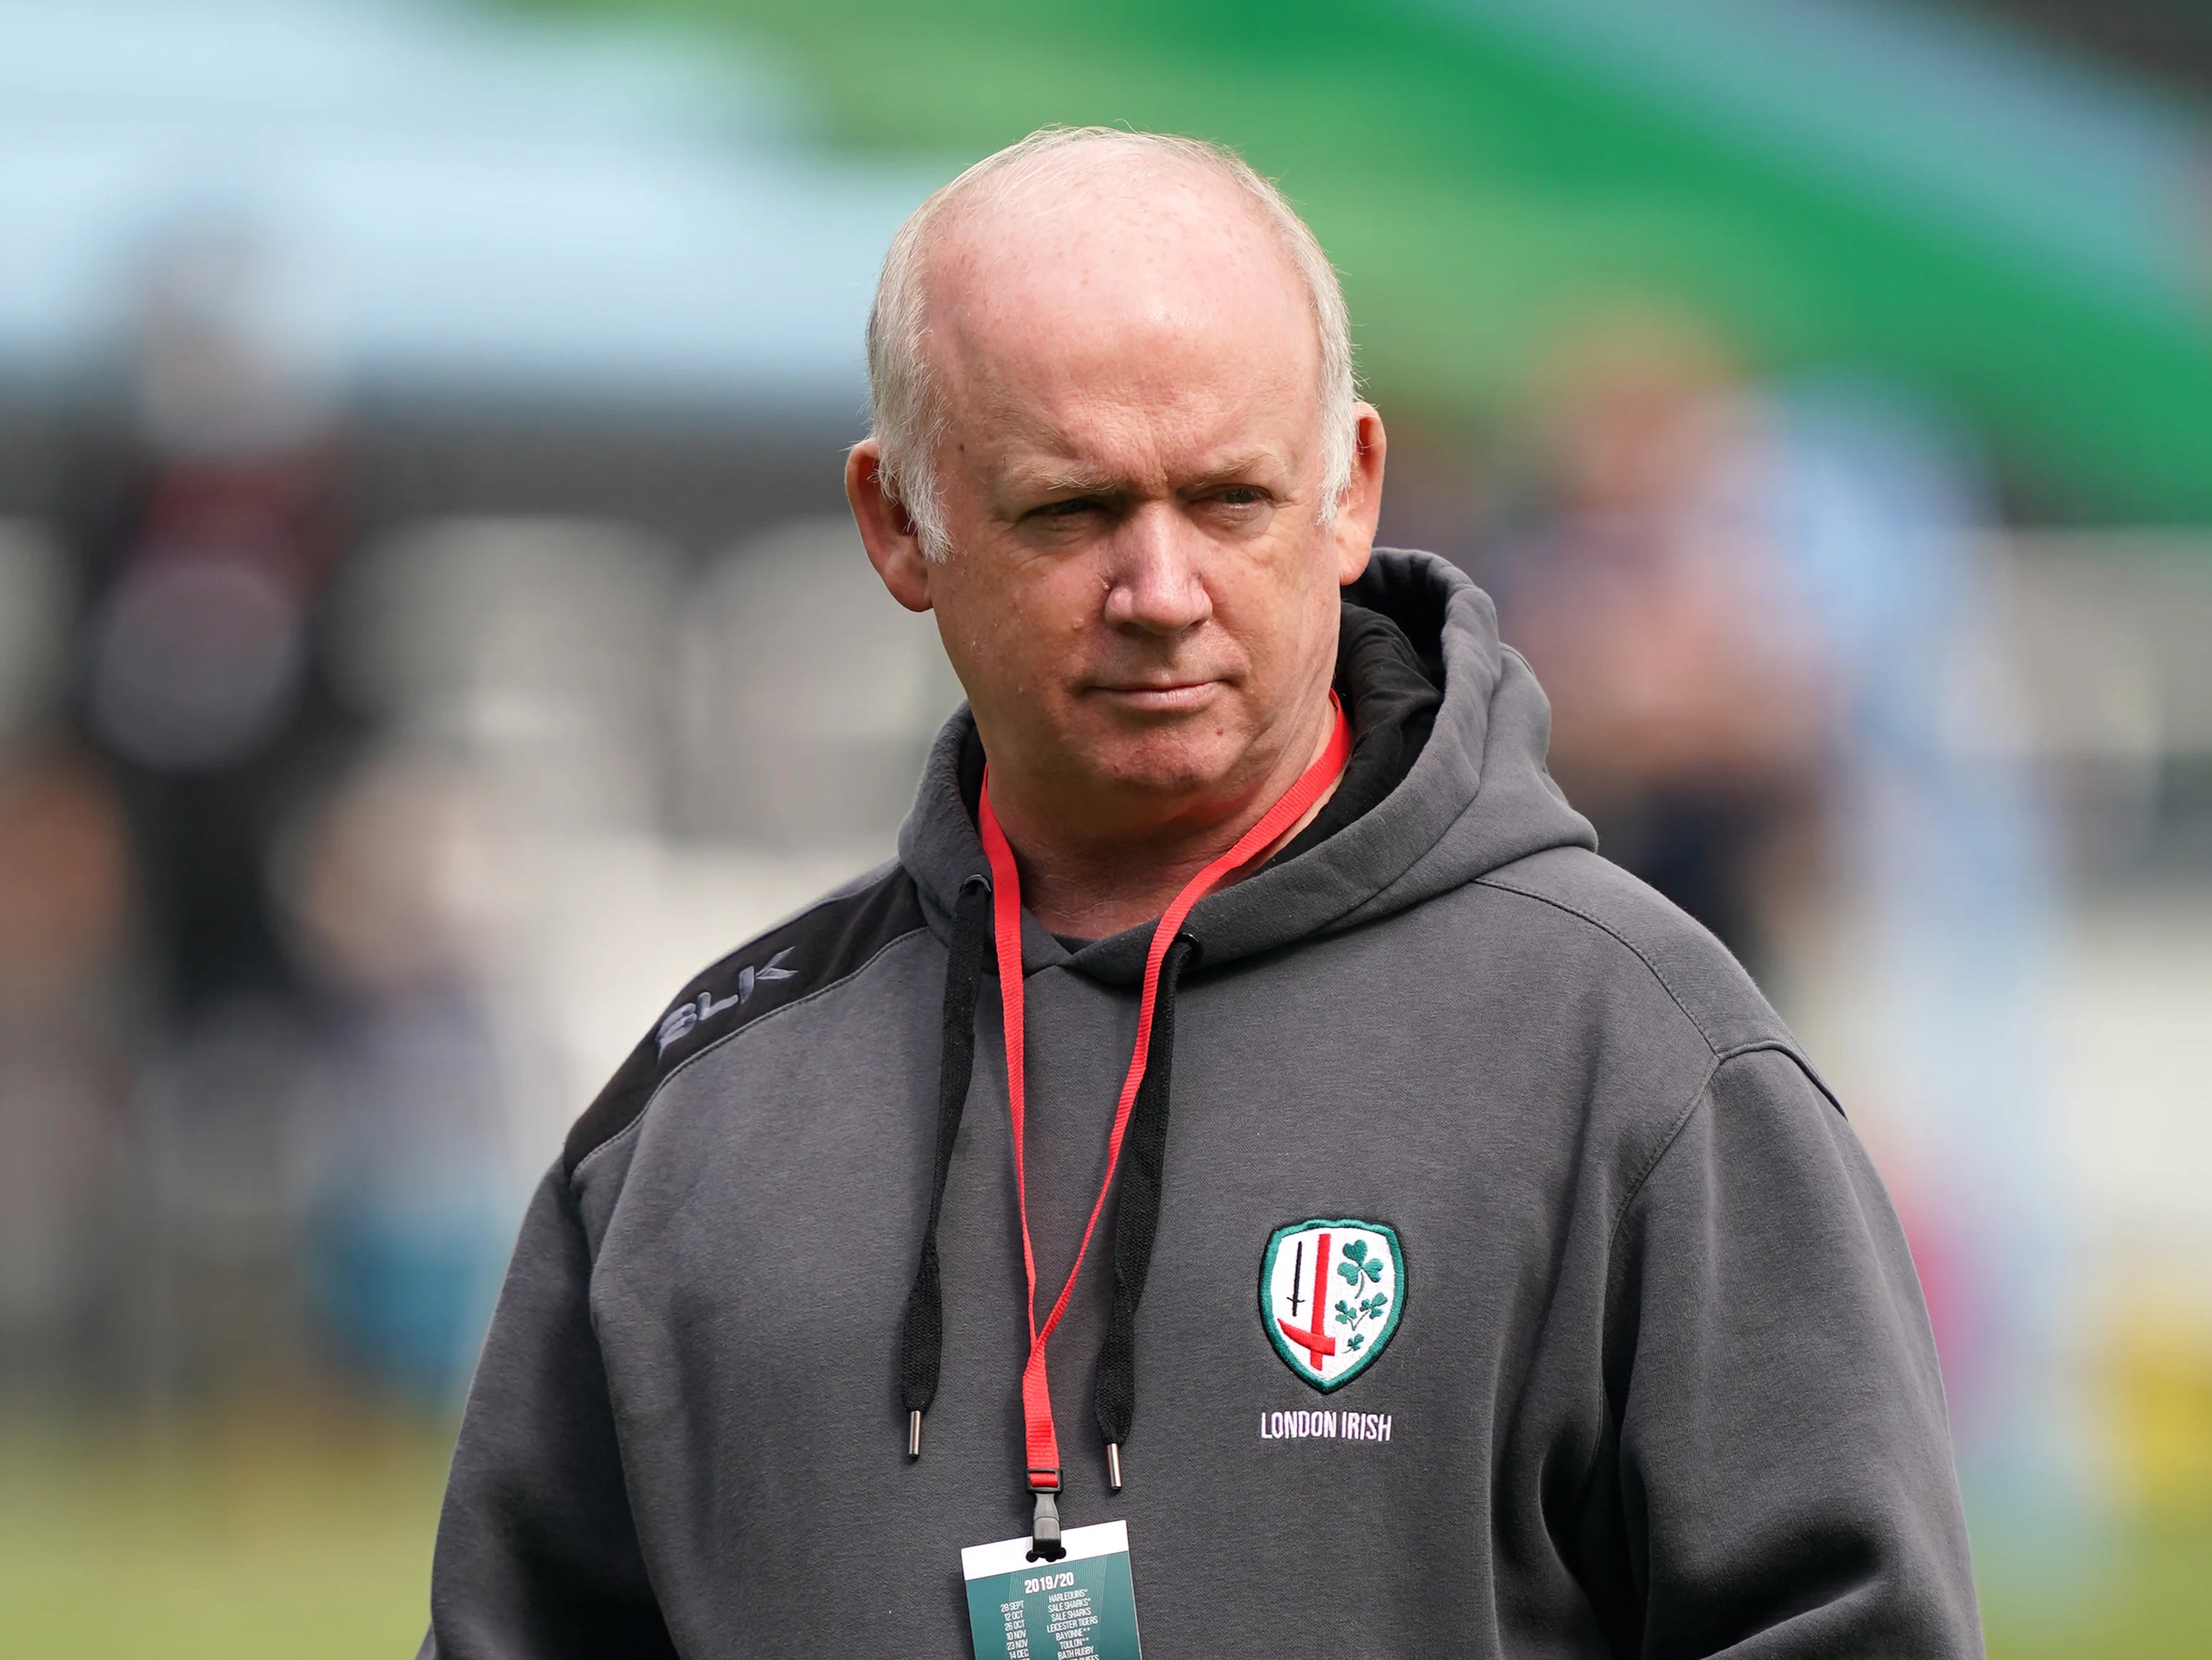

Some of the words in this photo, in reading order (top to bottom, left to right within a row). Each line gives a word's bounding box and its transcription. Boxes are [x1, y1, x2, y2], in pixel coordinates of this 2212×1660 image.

[656, 946, 799, 1065] BLK
[1261, 1411, 1336, 1439] LONDON
[1341, 1411, 1392, 1441] IRISH
[1025, 1572, 1074, 1593] 2019/20
[1000, 1603, 1009, 1612] 28
[1009, 1600, 1023, 1610] SEPT
[1048, 1603, 1064, 1613] SALE
[1004, 1613, 1011, 1621] 12
[1011, 1610, 1023, 1619] OCT
[1051, 1612, 1067, 1622] SALE
[1067, 1607, 1091, 1619] SHARKS
[1004, 1622, 1013, 1631] 26
[1014, 1619, 1025, 1629] OCT
[1046, 1619, 1078, 1633] LEICESTER
[1077, 1615, 1098, 1626] TIGERS
[1007, 1632, 1014, 1640] 10
[1014, 1629, 1026, 1639] NOV
[1007, 1642, 1015, 1651] 23
[1015, 1639, 1028, 1649] NOV
[1009, 1651, 1016, 1659] 14
[1016, 1649, 1029, 1658] DEC
[1058, 1650, 1074, 1660] BATH
[1074, 1645, 1093, 1657] RUGBY
